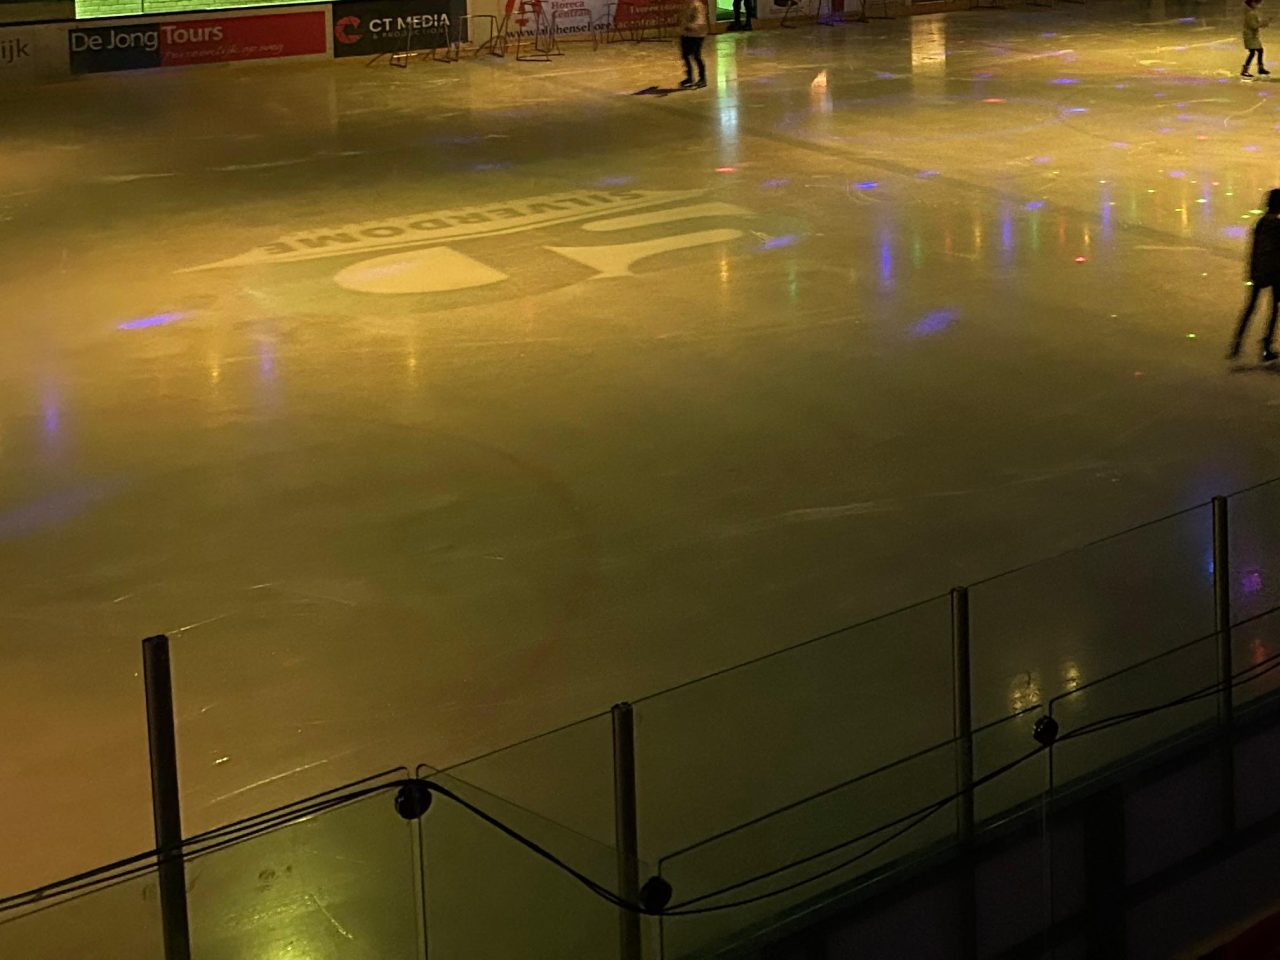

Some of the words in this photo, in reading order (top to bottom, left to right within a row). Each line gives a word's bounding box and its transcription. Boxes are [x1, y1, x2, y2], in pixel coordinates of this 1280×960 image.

[369, 18, 393, 33] CT
[397, 13, 451, 31] MEDIA
[71, 32, 103, 52] De
[106, 30, 158, 51] Jong
[161, 25, 224, 45] Tours
[262, 192, 644, 256] SILVERDOME
